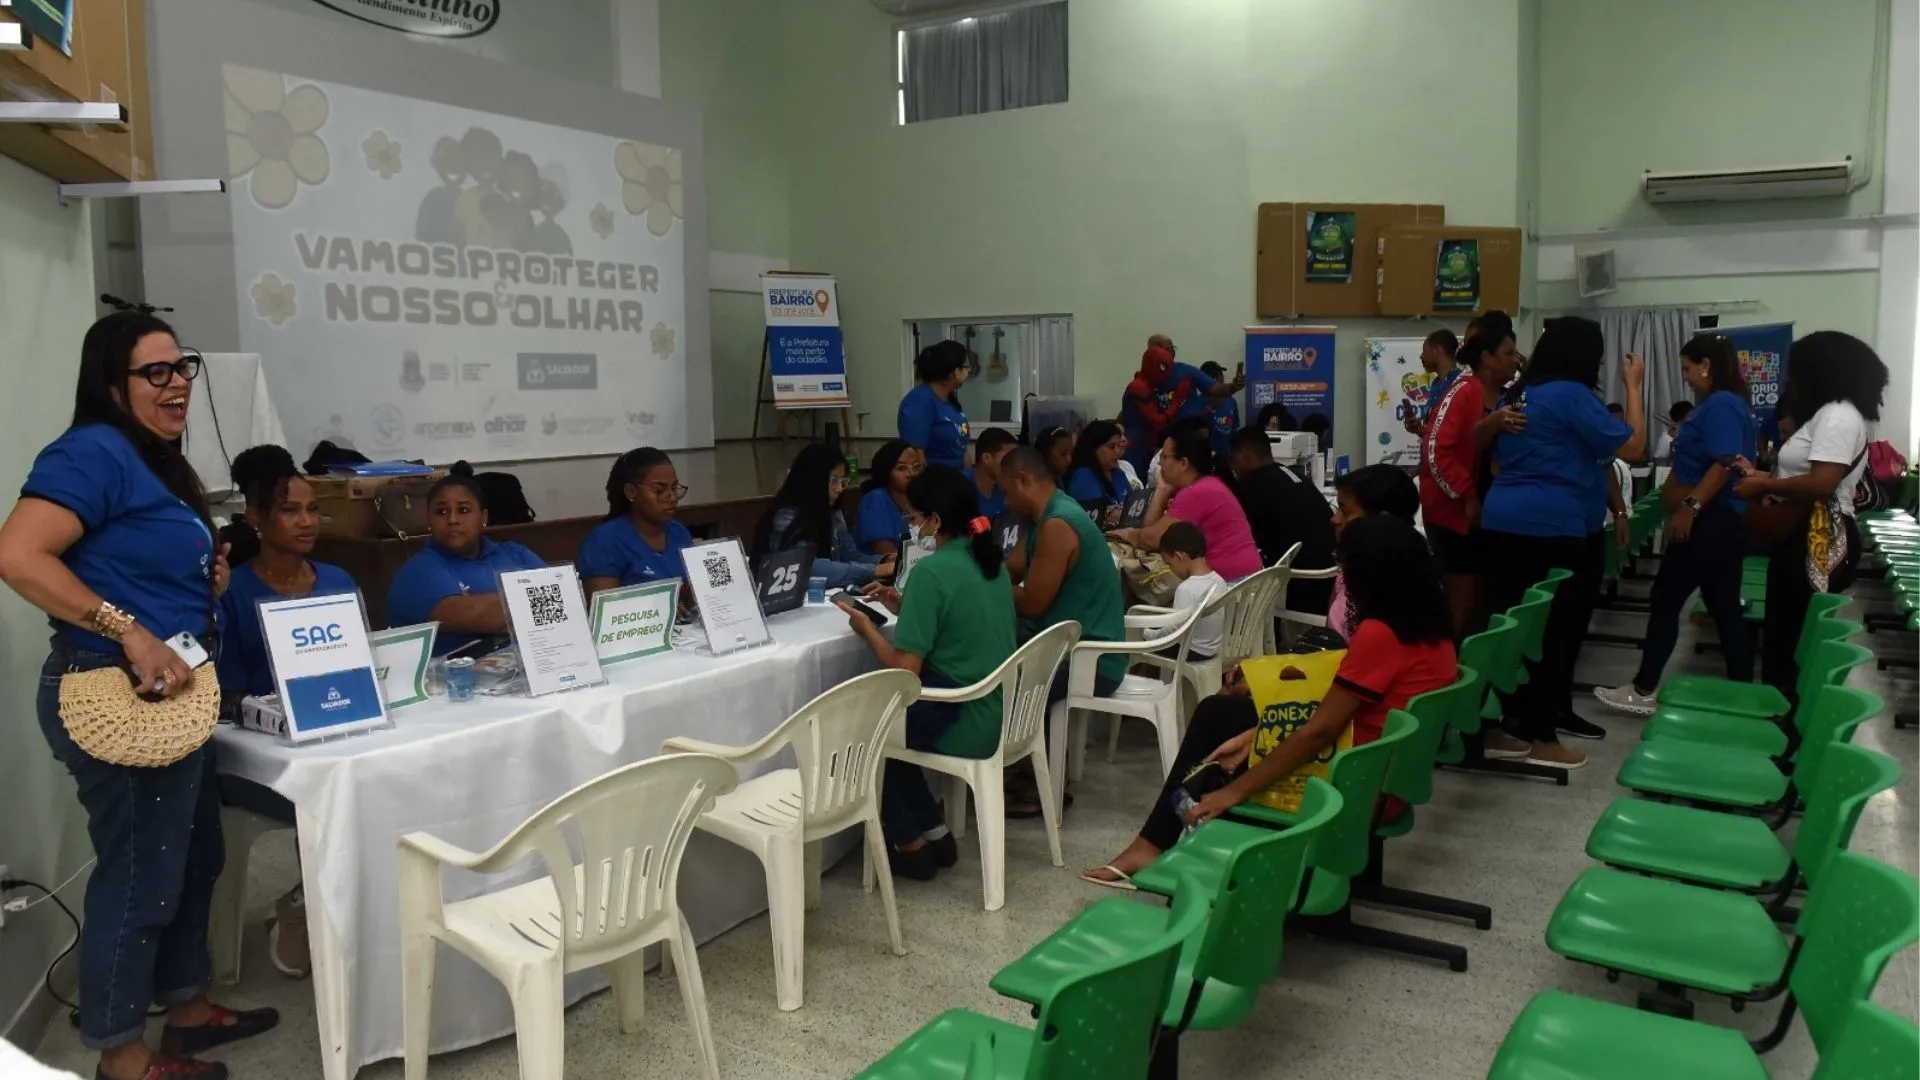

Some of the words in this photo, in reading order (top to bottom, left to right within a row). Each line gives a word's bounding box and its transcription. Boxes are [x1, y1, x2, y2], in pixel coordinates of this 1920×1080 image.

[295, 233, 457, 277] VAMOS
[466, 249, 659, 294] PROTEGER
[324, 282, 498, 327] NOSSO
[511, 295, 644, 334] OLHAR
[770, 295, 815, 306] BAIRRO
[793, 338, 830, 347] Prefeitura
[805, 347, 826, 357] perto
[785, 356, 796, 364] do
[1264, 353, 1303, 362] BAIRRO
[1127, 499, 1146, 518] 49
[1002, 525, 1020, 549] 14
[768, 563, 800, 596] 25
[611, 608, 660, 626] PESQUISA
[291, 623, 344, 648] SAC
[600, 633, 615, 644] DE
[616, 623, 664, 641] EMPREGO
[1262, 703, 1318, 724] CONEXÃ
